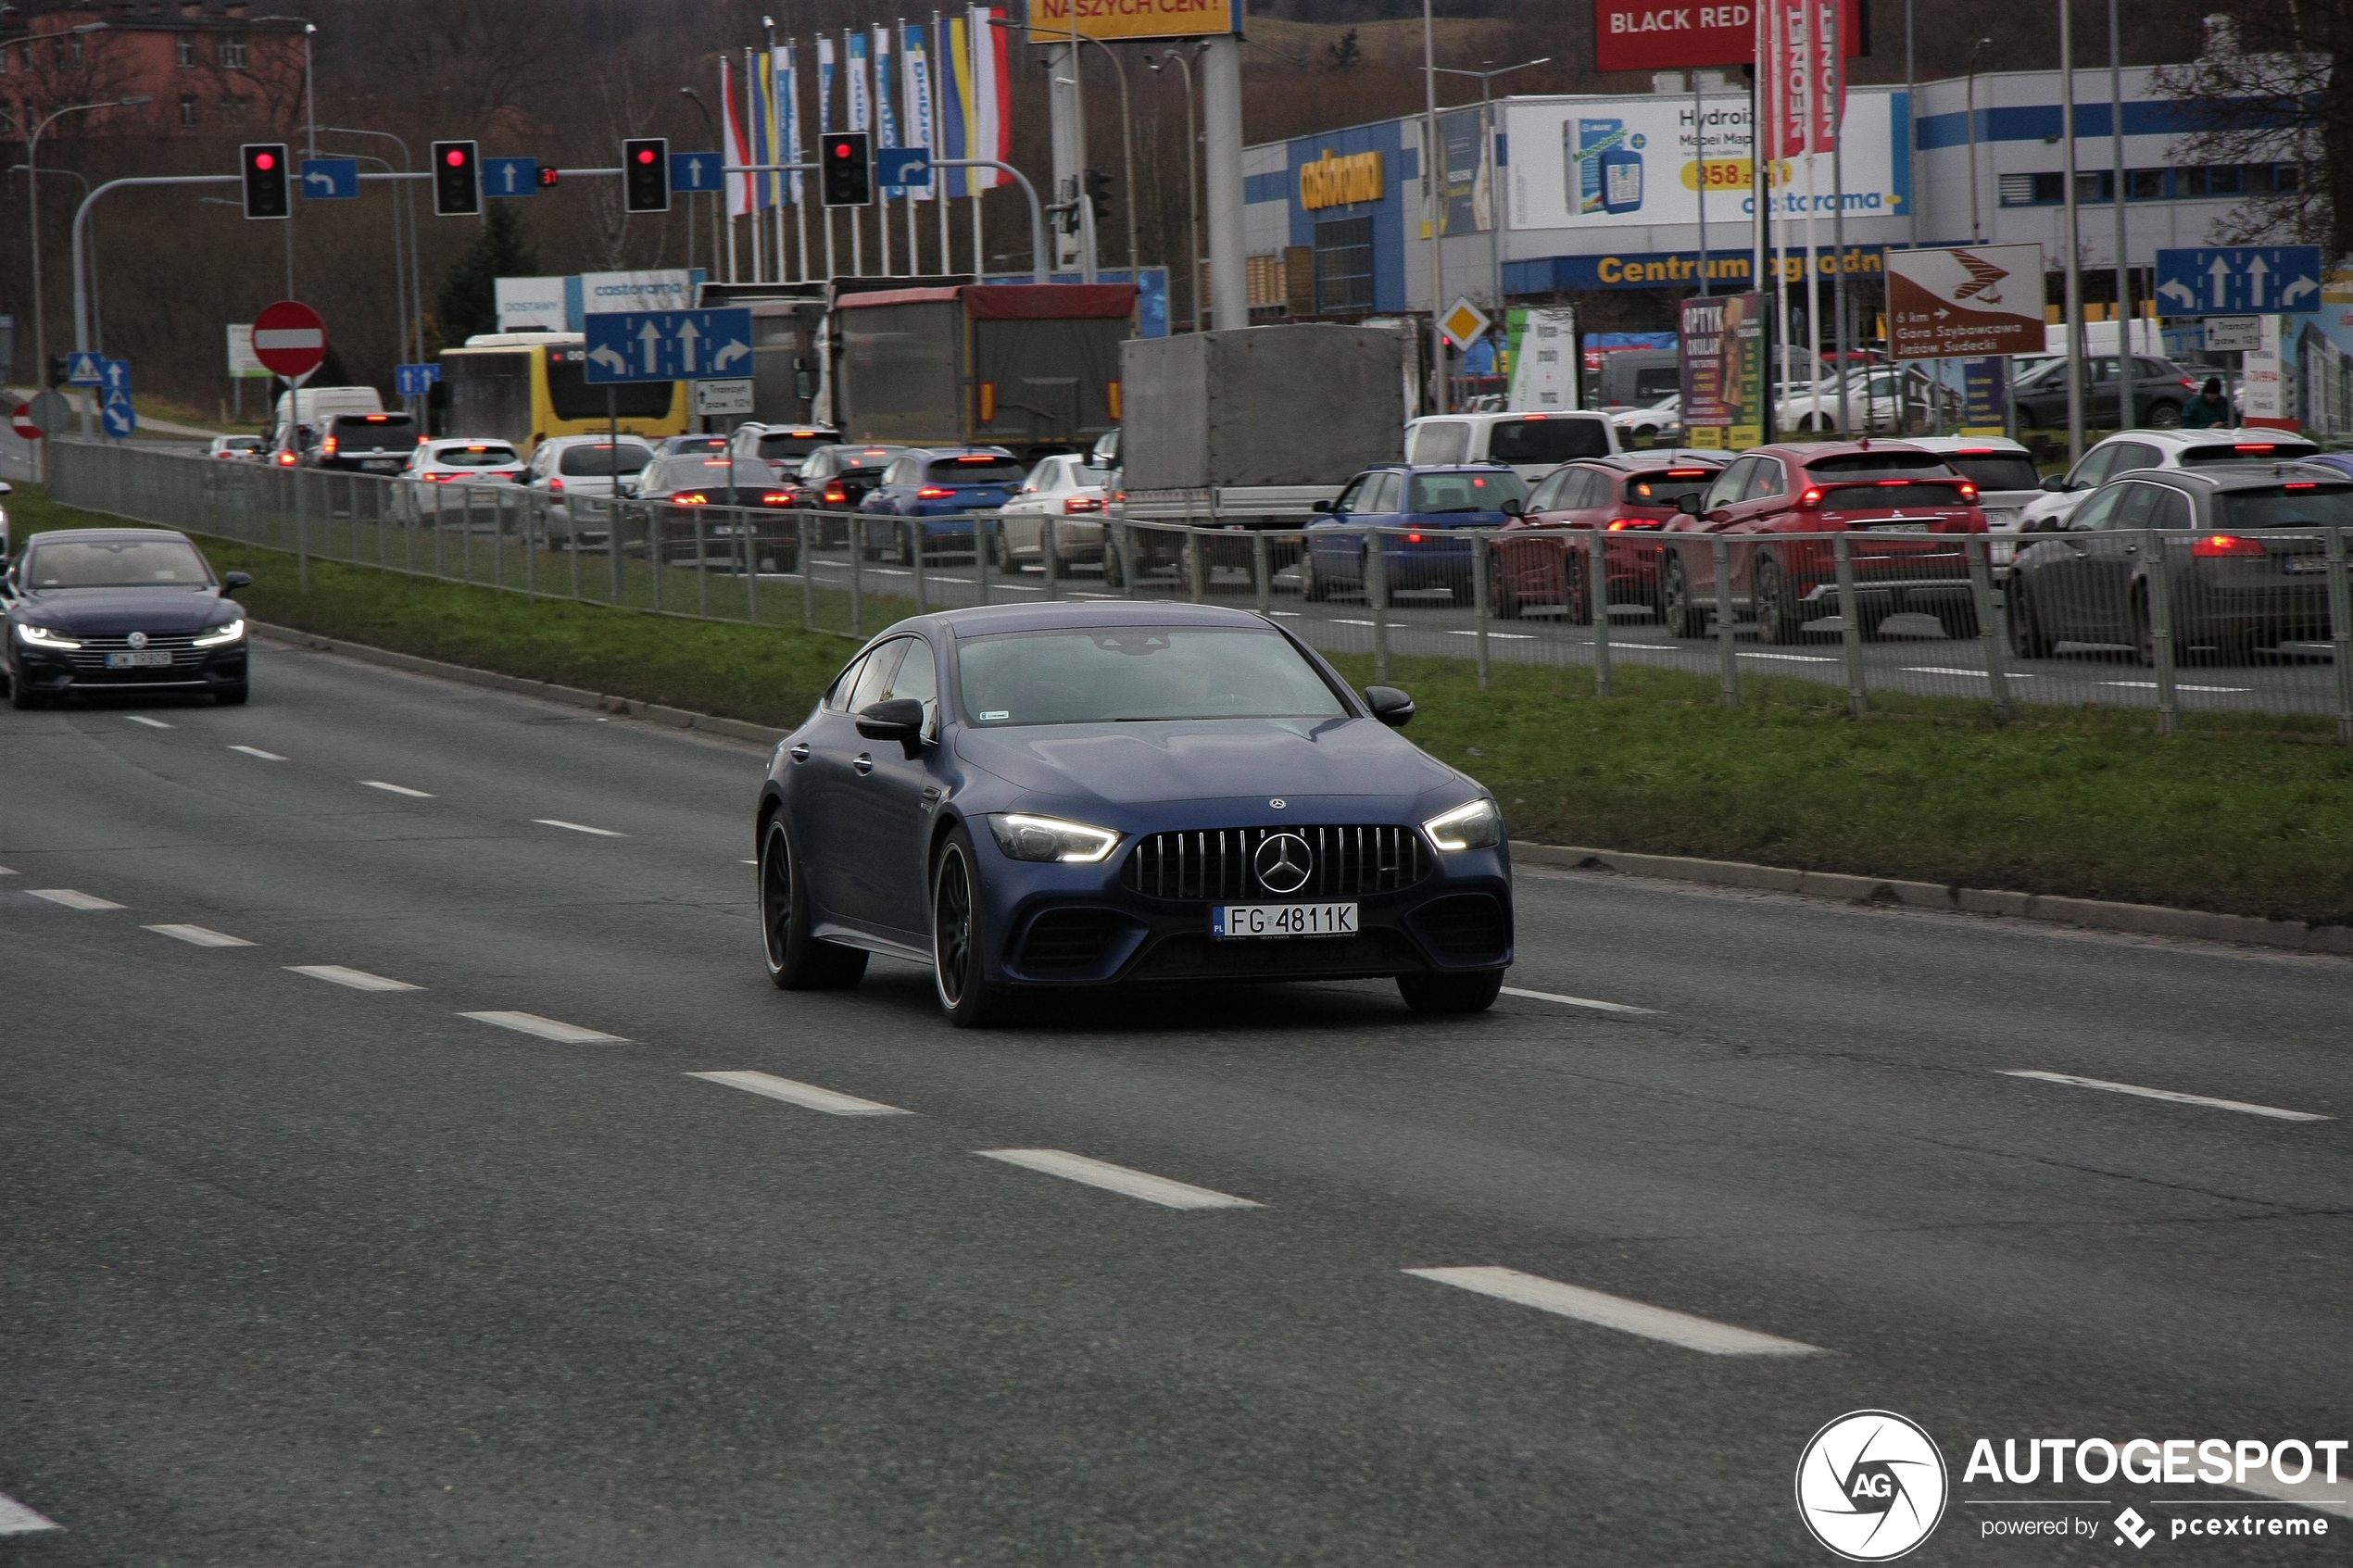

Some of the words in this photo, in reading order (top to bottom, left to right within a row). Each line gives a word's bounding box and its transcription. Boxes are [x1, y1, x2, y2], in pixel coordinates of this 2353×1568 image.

[1043, 0, 1153, 19] NASZYCH
[1610, 8, 1692, 33] BLACK
[1699, 6, 1751, 29] RED
[1787, 5, 1806, 138] NEONET
[1597, 256, 1750, 284] Centrum
[595, 282, 681, 295] castorama
[1896, 312, 1906, 323] 6
[1909, 311, 1930, 322] km
[1944, 338, 1998, 352] Sudecki
[1230, 908, 1265, 934] FG
[1275, 906, 1352, 933] 4811K
